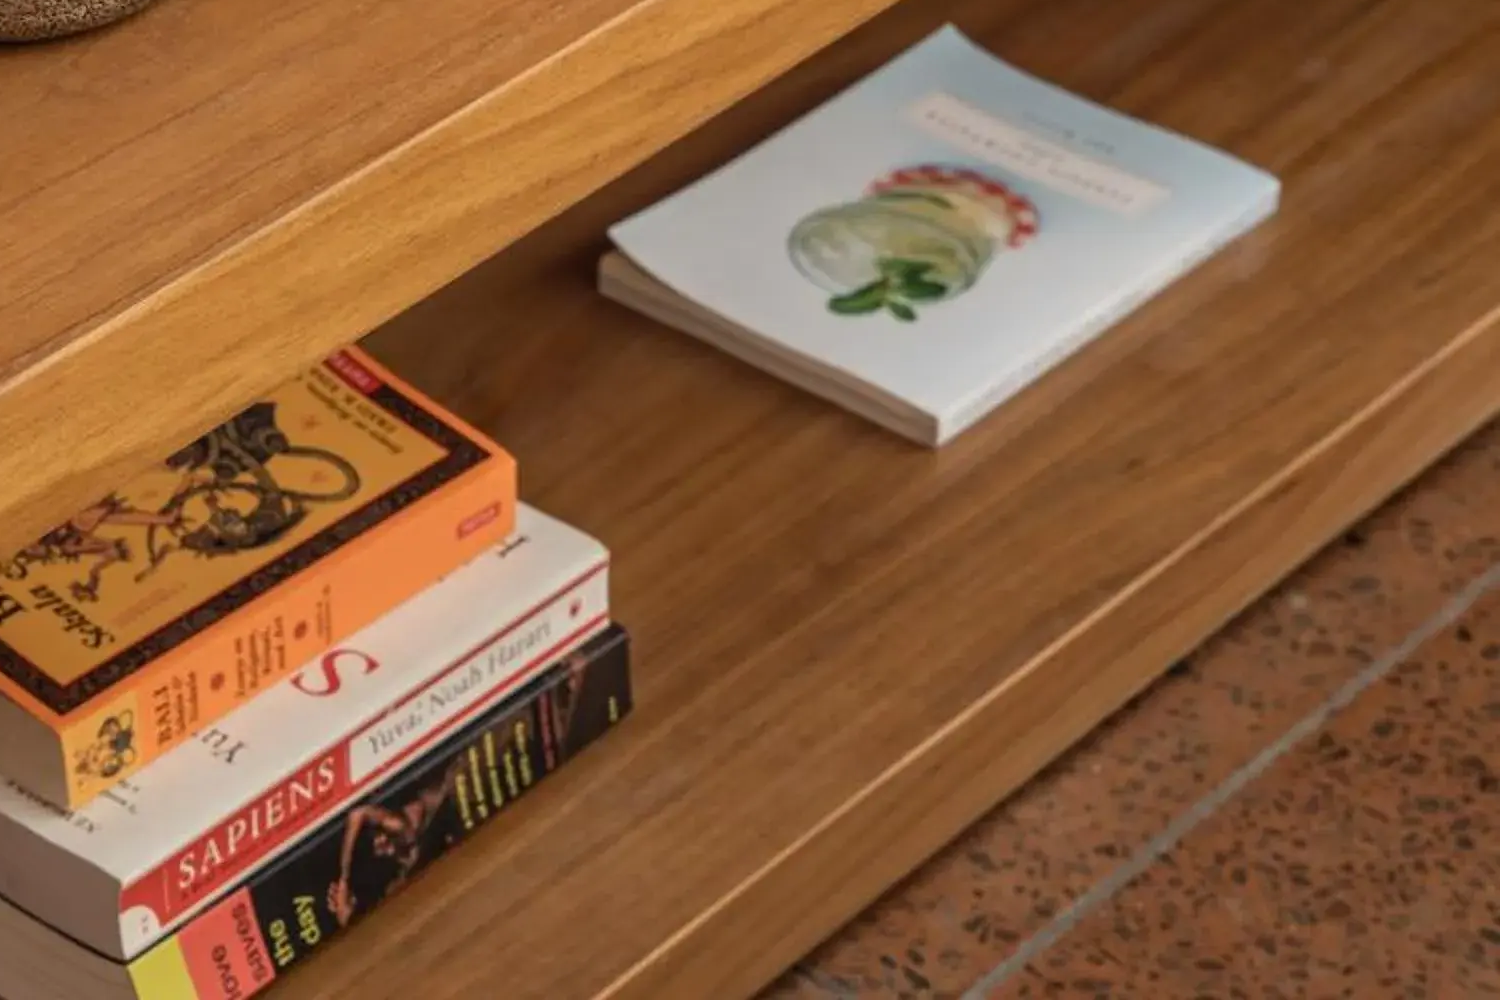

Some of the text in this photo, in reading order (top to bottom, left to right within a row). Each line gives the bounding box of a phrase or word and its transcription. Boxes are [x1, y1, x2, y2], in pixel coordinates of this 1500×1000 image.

[29, 584, 116, 648] Sekala
[428, 663, 483, 715] Noah
[486, 622, 552, 675] Harari
[153, 686, 174, 746] BALI
[178, 756, 336, 889] SAPIENS
[231, 902, 269, 982] saves
[268, 919, 296, 966] the
[292, 895, 321, 945] day
